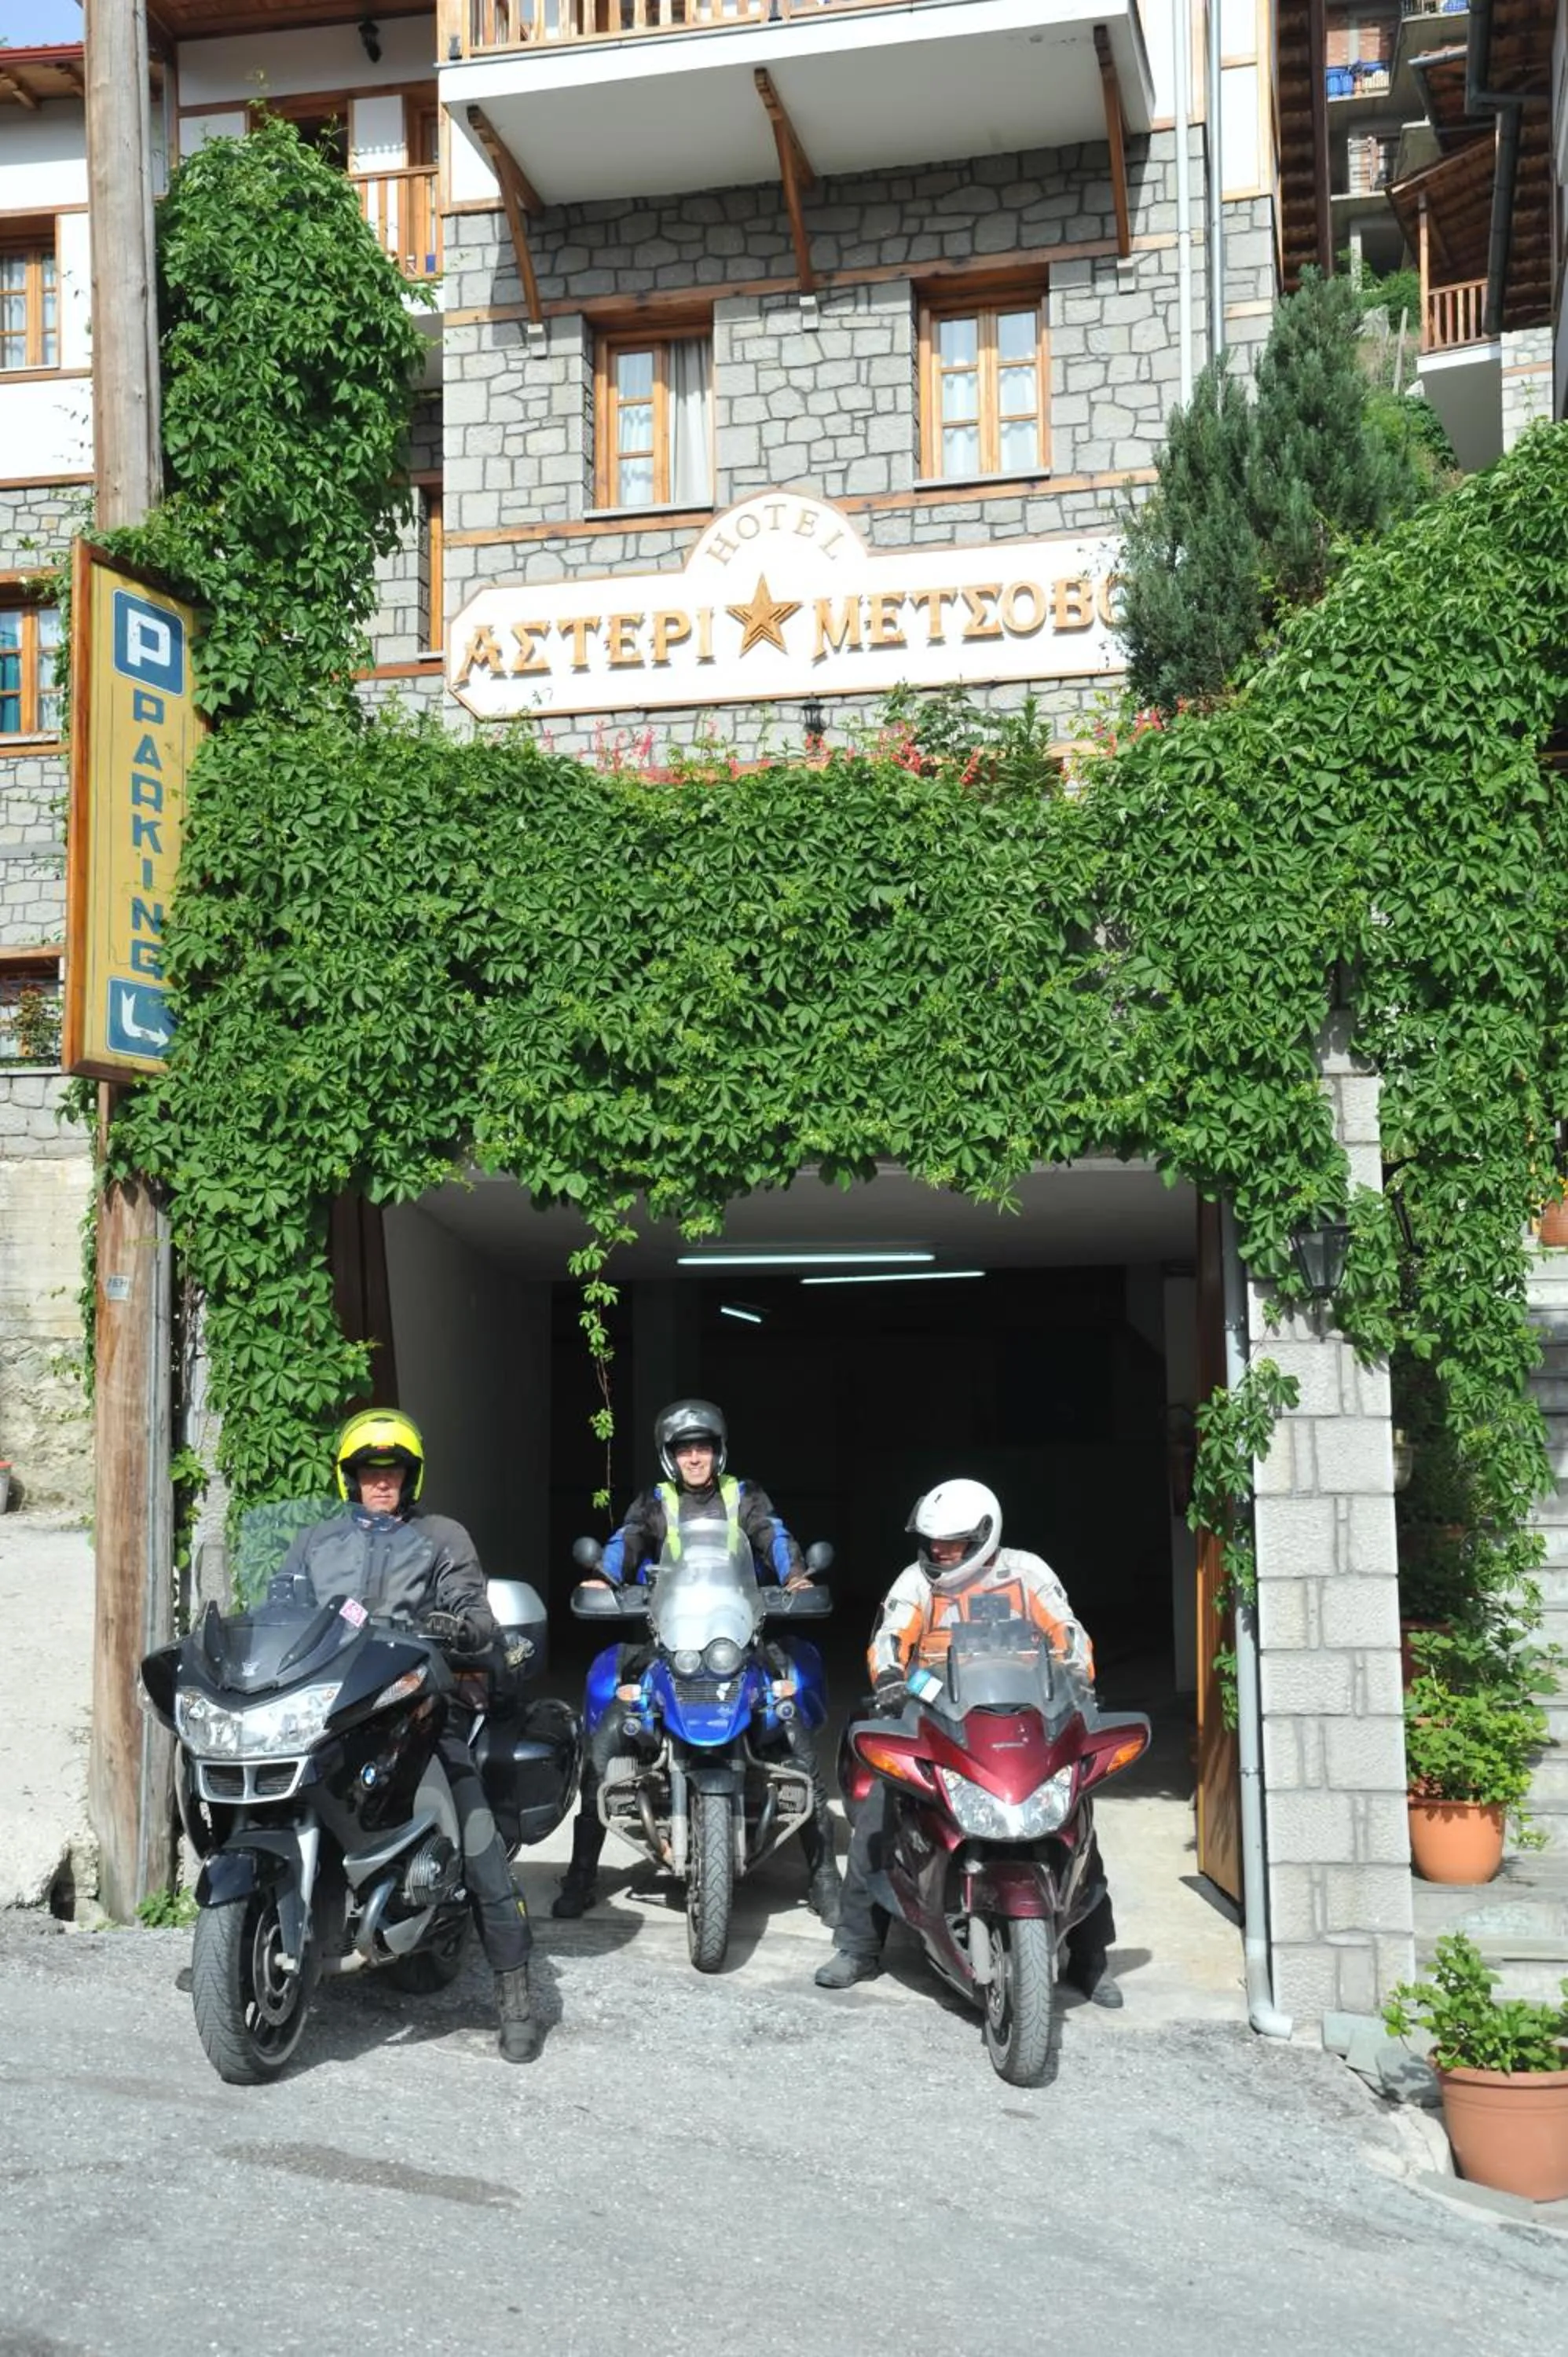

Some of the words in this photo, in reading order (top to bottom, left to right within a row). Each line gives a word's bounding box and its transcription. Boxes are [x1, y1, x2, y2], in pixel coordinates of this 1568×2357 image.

[705, 504, 844, 566] HOTEL
[127, 608, 170, 666] P
[452, 606, 714, 688] ΑΣΤΕΡΙ
[131, 688, 164, 981] PARKING
